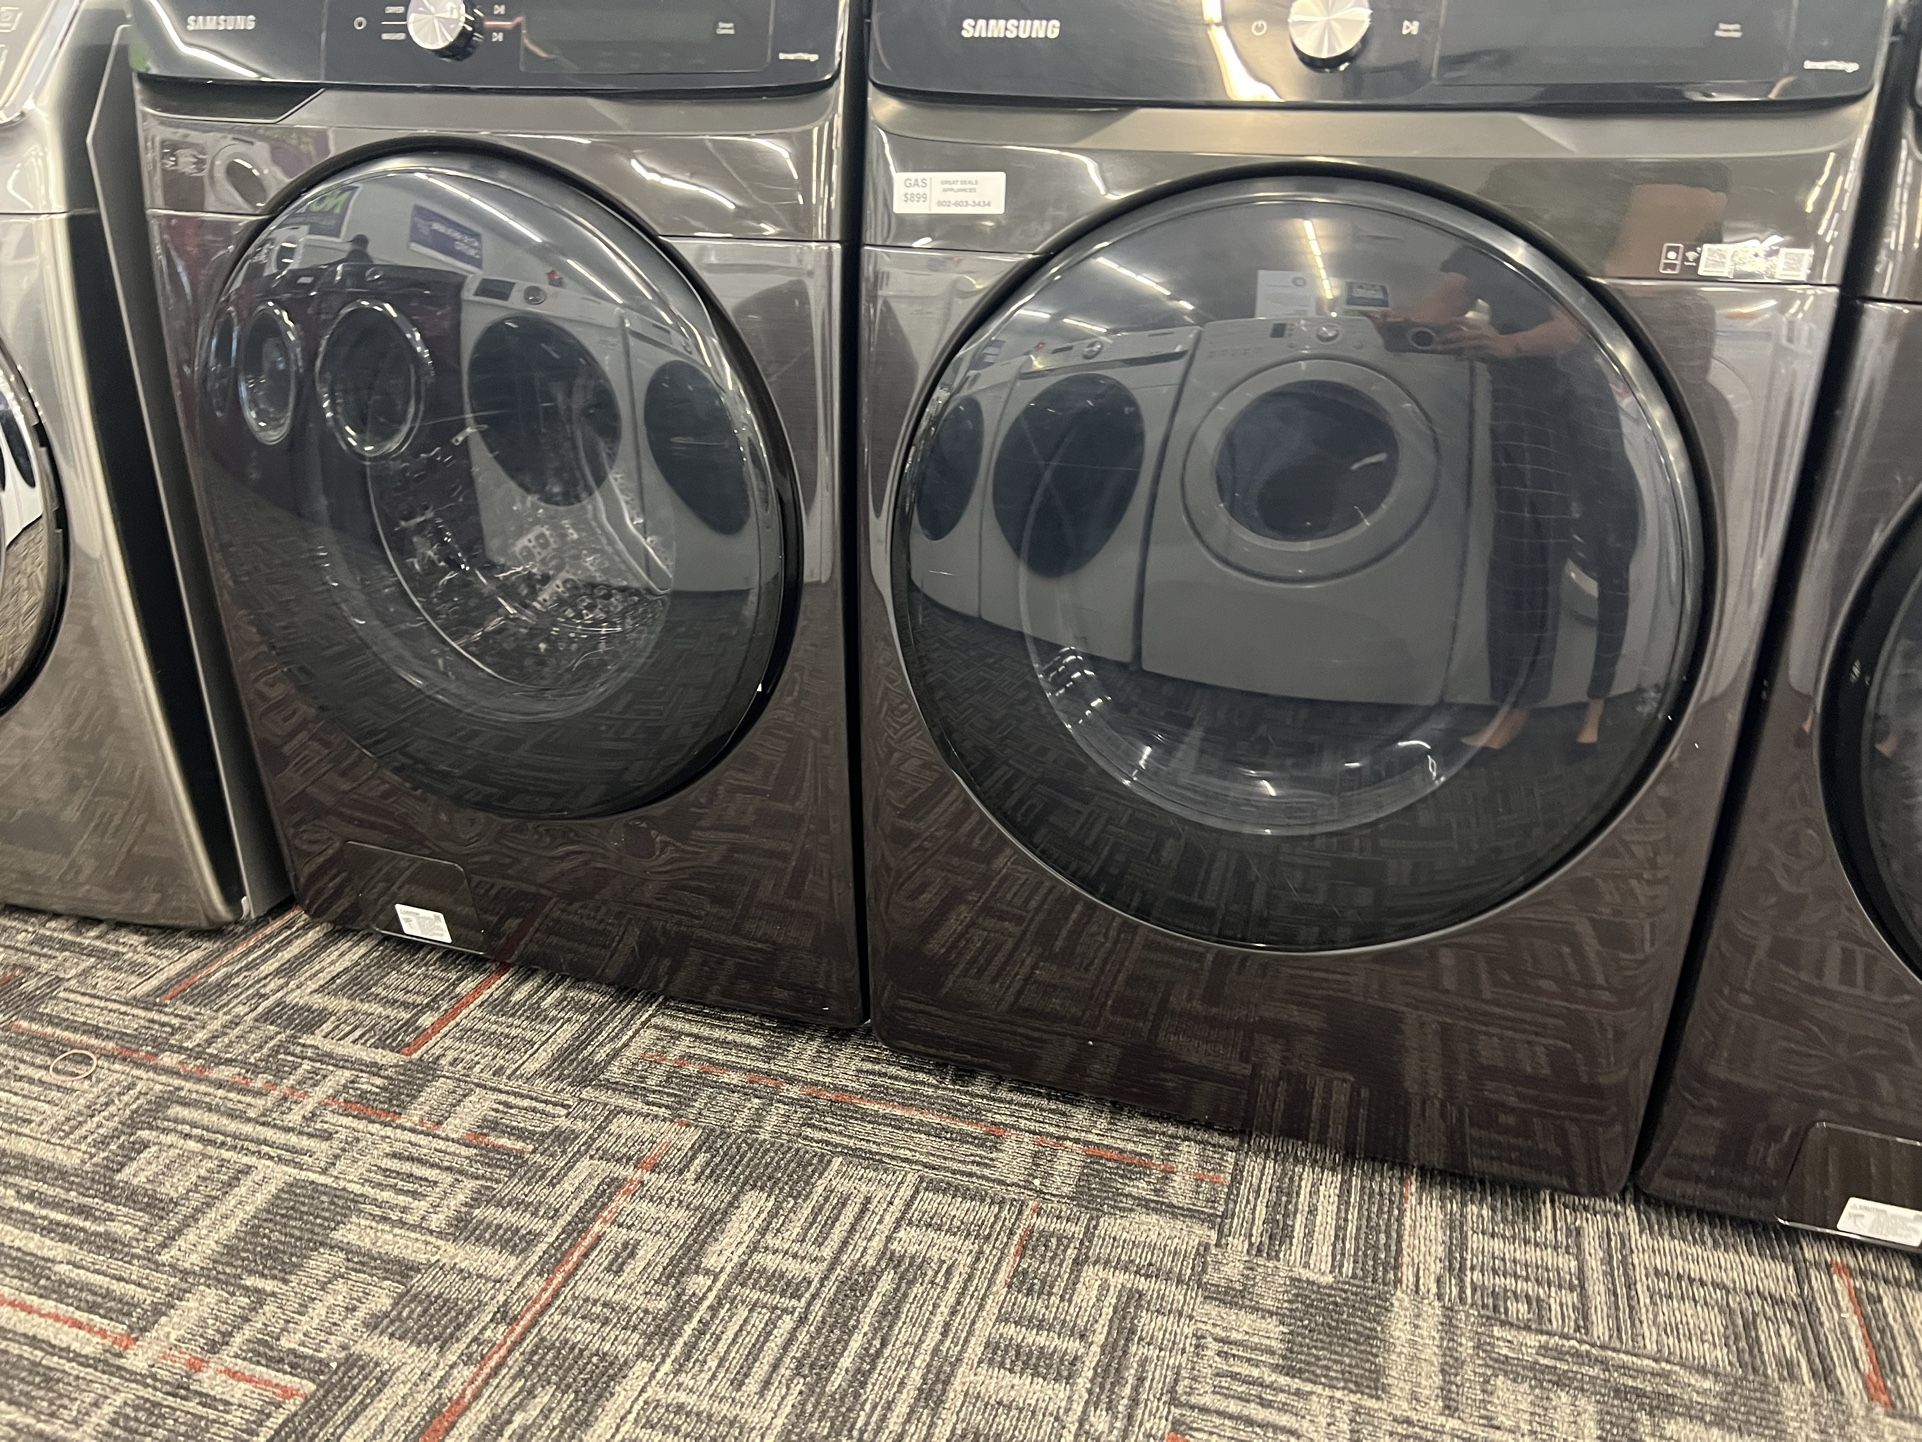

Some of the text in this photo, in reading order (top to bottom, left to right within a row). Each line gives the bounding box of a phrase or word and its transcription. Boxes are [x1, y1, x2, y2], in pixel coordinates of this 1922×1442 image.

[186, 15, 256, 31] SAMSUNG
[961, 18, 1061, 39] SAMSUNG
[903, 177, 928, 189] GAS
[903, 192, 928, 203] $899
